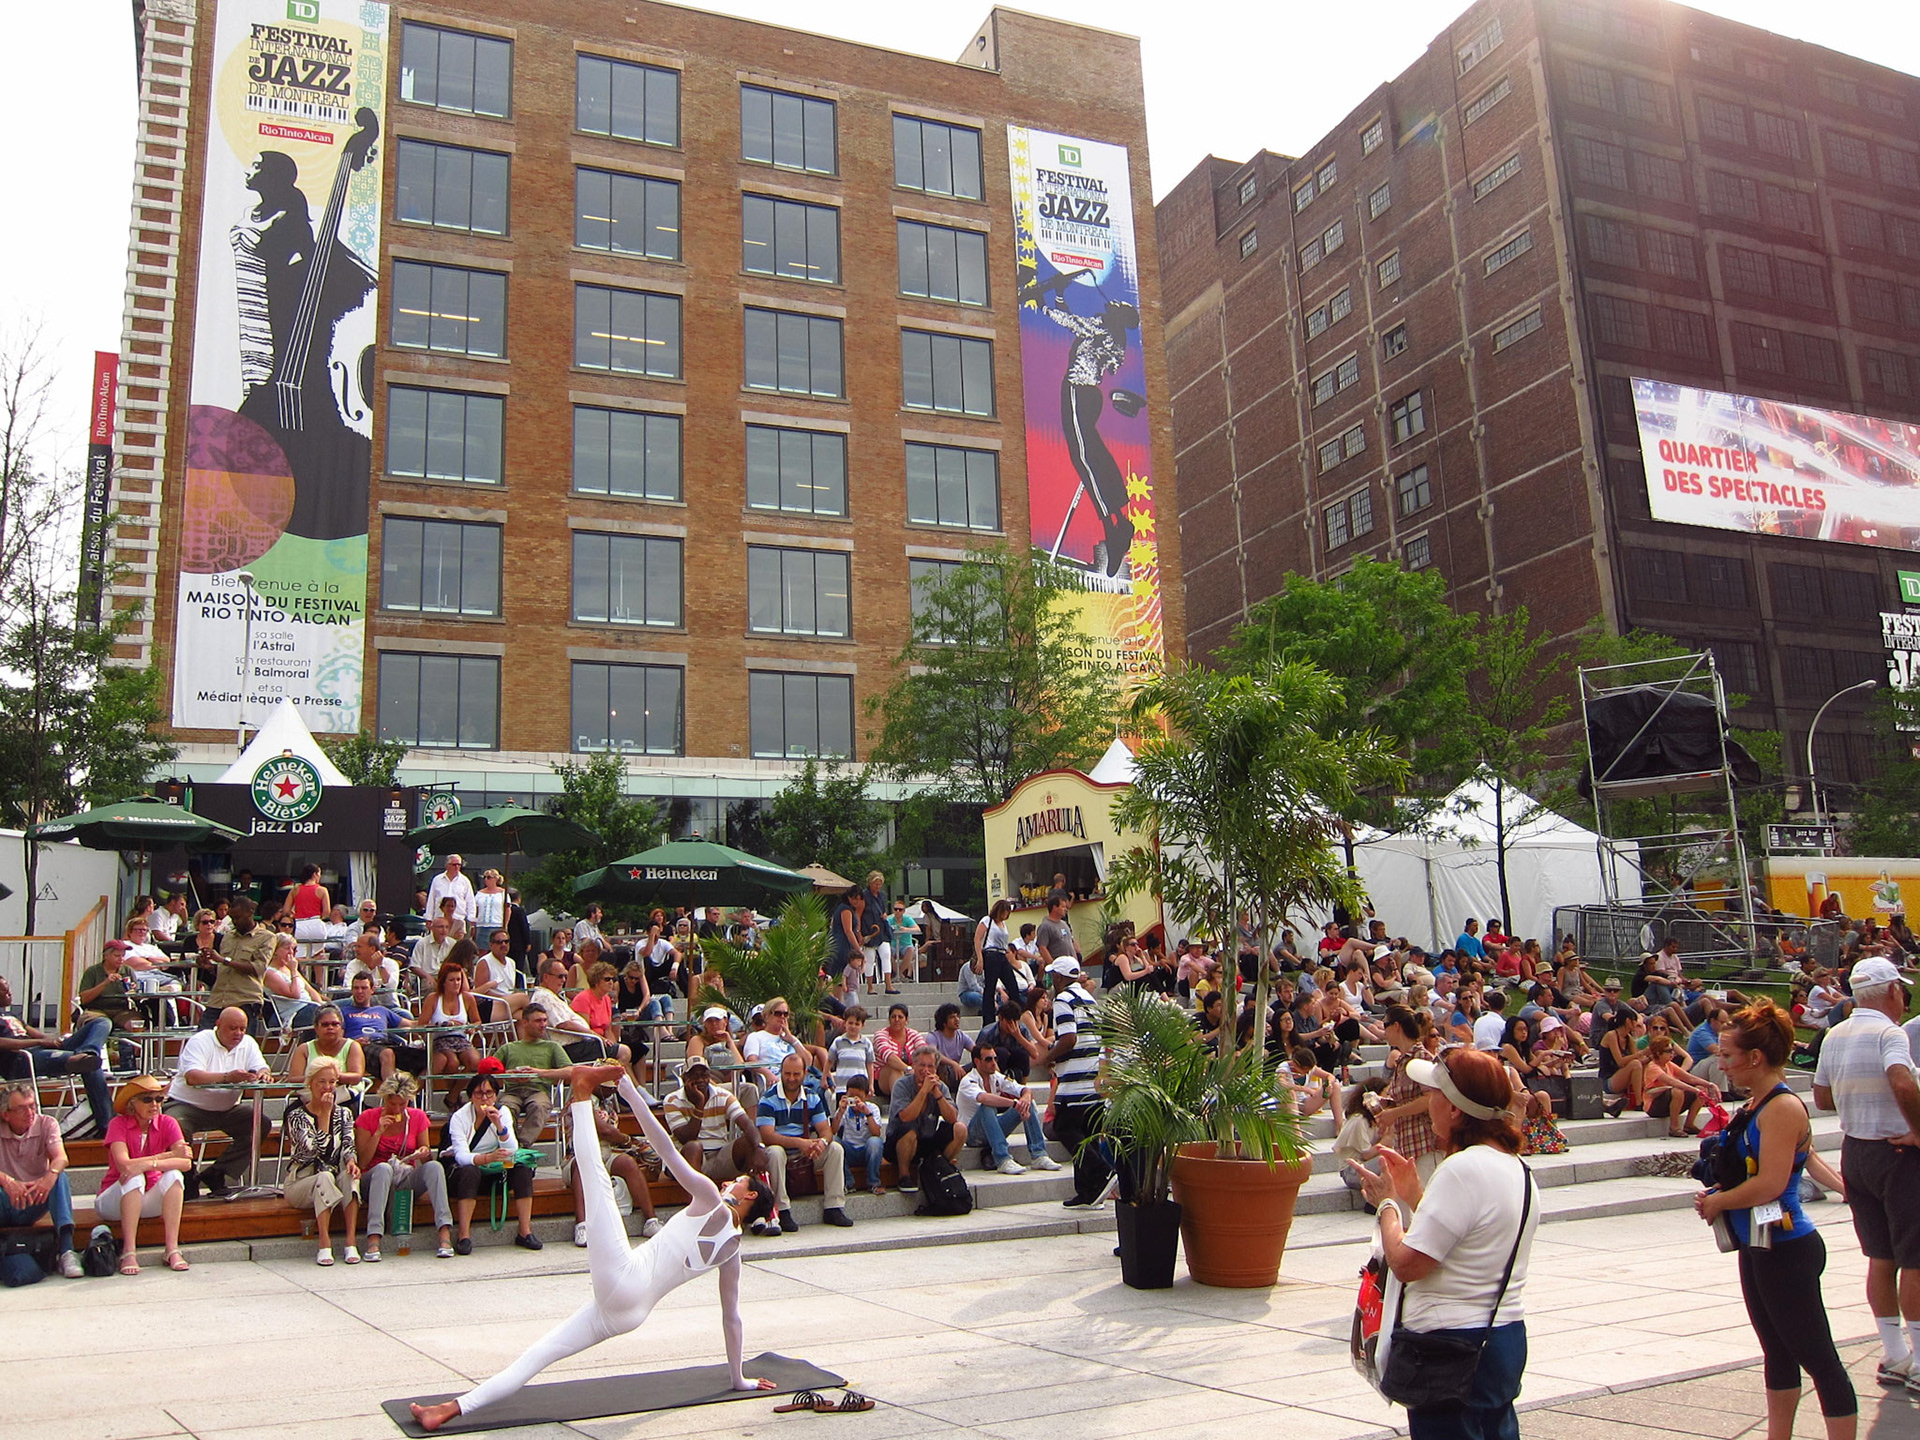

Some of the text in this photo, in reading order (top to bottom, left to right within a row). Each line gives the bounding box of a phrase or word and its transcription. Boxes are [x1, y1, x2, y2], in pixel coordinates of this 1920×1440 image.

[289, 0, 317, 19] TD
[250, 23, 352, 55] FESTIVAL
[250, 38, 352, 67] INTERNATIONAL
[248, 52, 351, 96] DE JAZZ
[248, 82, 350, 109] DE MONTREAL
[261, 124, 332, 143] Rio Tinto Alcan
[1060, 149, 1079, 163] TD
[1036, 168, 1108, 194] FESTIVAL
[1037, 181, 1109, 203] INTERNATIONAL
[1039, 193, 1111, 229] JAZZ
[1040, 218, 1112, 240] DE MONTREAL
[1052, 253, 1102, 269] Rio Tinto Alcan
[96, 372, 111, 437] Rio Tinto Alcan
[1658, 439, 1760, 474] QUARTIER
[91, 455, 107, 502] Festival
[1663, 469, 1827, 511] DES SPECTACLES
[90, 503, 102, 524] du
[307, 580, 319, 593] à
[324, 581, 339, 594] la
[186, 591, 361, 613] MAISON DU FESTIVAL
[201, 607, 231, 619] RIO
[290, 612, 351, 626] ALCAN
[255, 630, 294, 641] sa salle
[1134, 637, 1146, 647] la
[253, 641, 295, 652] l'Astral
[1096, 649, 1112, 659] DU
[1116, 650, 1162, 662] FESTIVAL
[256, 657, 312, 667] restaurant
[1079, 660, 1112, 671] TINTO
[1116, 662, 1156, 673] ALCAN
[254, 667, 309, 679] Balmoral
[258, 684, 283, 693] et sa
[304, 696, 343, 707] Presse
[255, 761, 316, 792] Heineken
[262, 799, 310, 819] Bière
[425, 796, 455, 817] Heineken
[128, 816, 197, 825] Heineken
[249, 817, 286, 836] jazz
[291, 821, 323, 834] bar
[1014, 805, 1089, 852] AMARULA
[645, 867, 718, 881] Heineken
